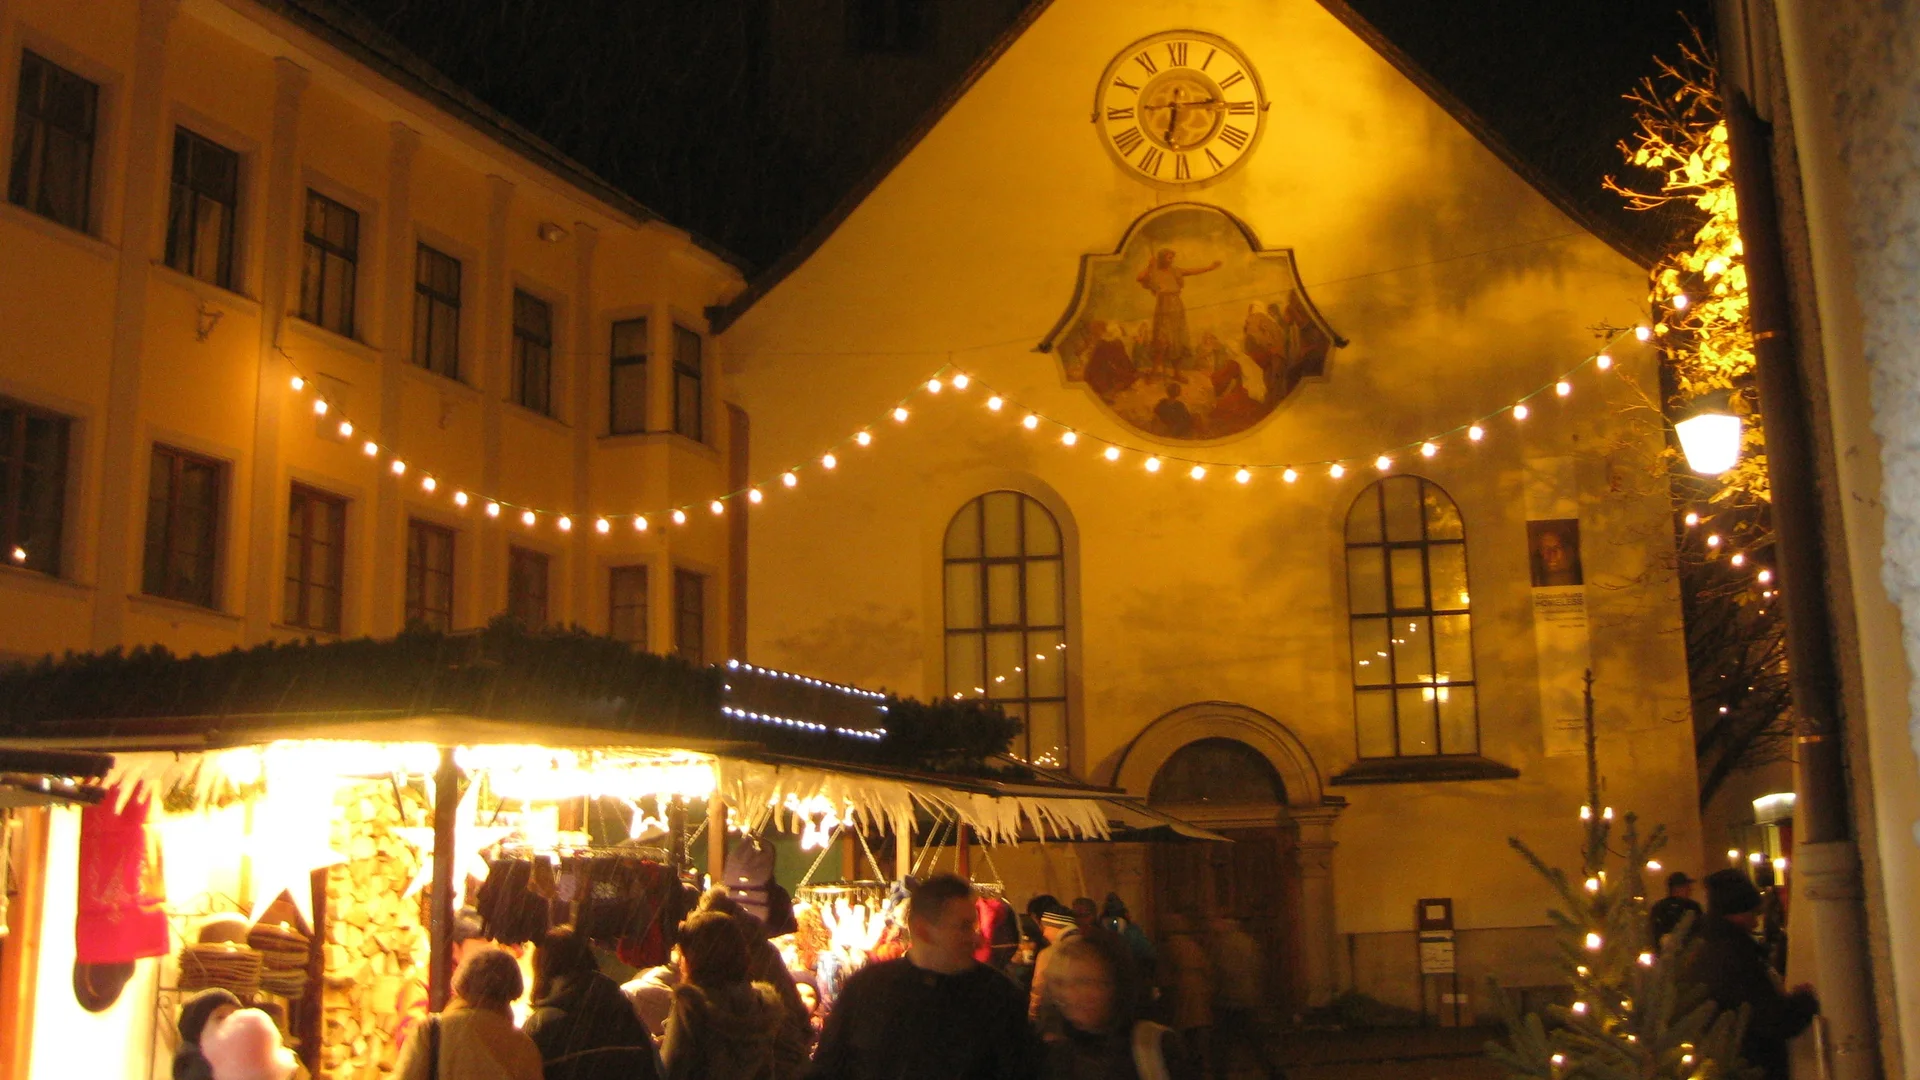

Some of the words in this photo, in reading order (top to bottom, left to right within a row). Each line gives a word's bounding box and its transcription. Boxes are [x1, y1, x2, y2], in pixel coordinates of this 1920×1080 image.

[1134, 51, 1158, 77] XI
[1167, 43, 1188, 67] XII
[1113, 76, 1140, 95] X
[1218, 70, 1245, 91] II
[1107, 107, 1134, 120] IX
[1175, 153, 1191, 179] VI
[1205, 147, 1223, 171] V
